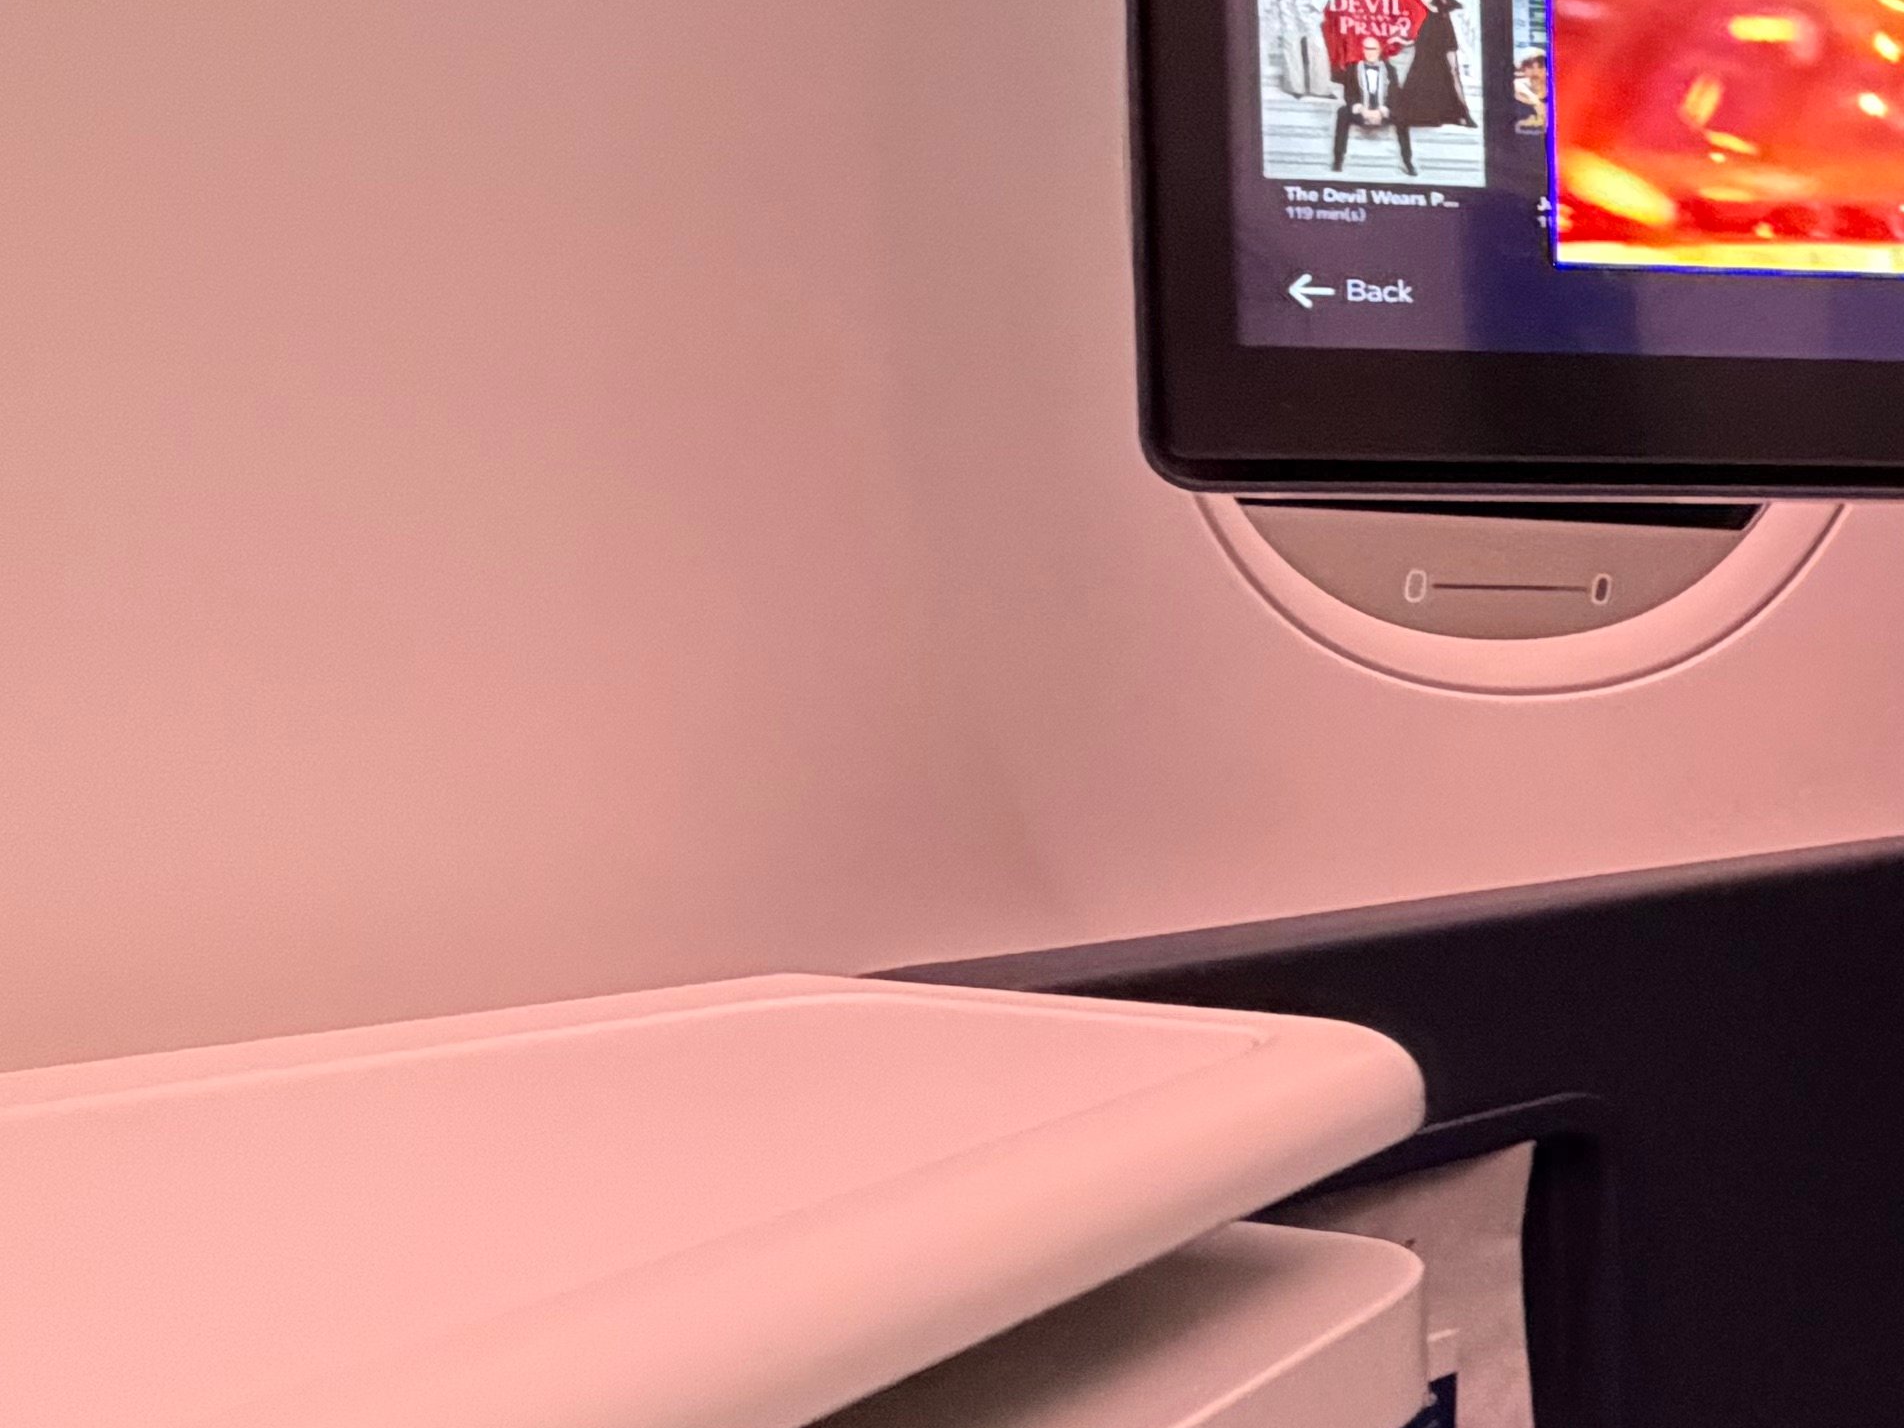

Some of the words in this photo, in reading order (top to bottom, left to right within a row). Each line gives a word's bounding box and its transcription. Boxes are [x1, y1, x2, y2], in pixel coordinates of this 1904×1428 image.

[1284, 186, 1318, 202] The
[1322, 187, 1367, 204] Devil
[1370, 190, 1427, 206] Wears
[1316, 207, 1367, 223] min(s)
[1346, 278, 1414, 303] Back
